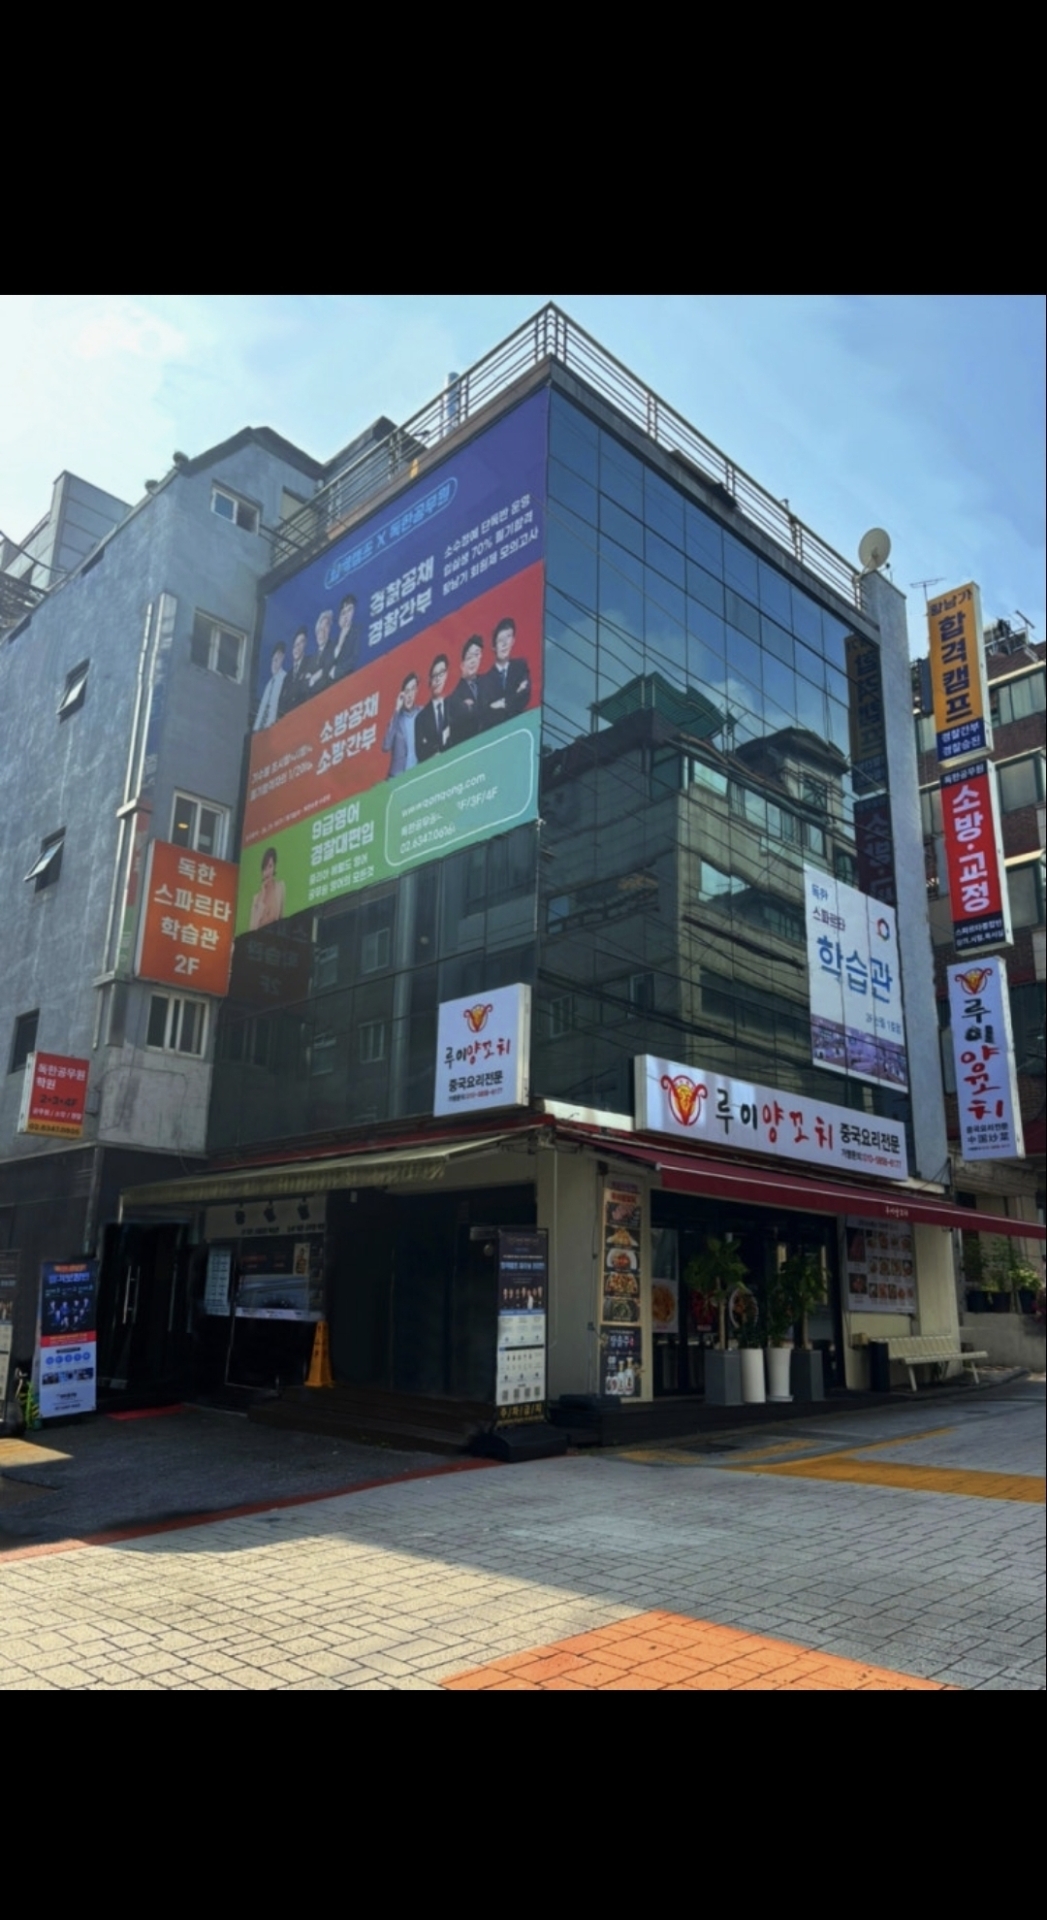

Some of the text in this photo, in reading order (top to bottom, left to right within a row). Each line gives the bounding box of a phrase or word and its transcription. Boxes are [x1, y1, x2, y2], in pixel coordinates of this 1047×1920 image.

[500, 526, 538, 560] 모의고사
[370, 555, 434, 617] 경찰공채
[368, 586, 432, 647] 경찰간부
[938, 611, 972, 724] 합격캠프
[320, 691, 379, 744] 소방공채
[941, 721, 980, 744] 경찰간부
[316, 722, 377, 776] 소방간부
[312, 801, 360, 840] 9급영어
[311, 819, 374, 867] 경찰대편입
[178, 856, 217, 886] 독한
[154, 883, 232, 922] 스파르타
[161, 916, 220, 951] 학습관
[174, 954, 200, 976] 2F
[816, 935, 893, 1004] 학습관
[449, 1070, 503, 1093] 중국요리전문
[840, 1122, 900, 1154] 중국요리전문
